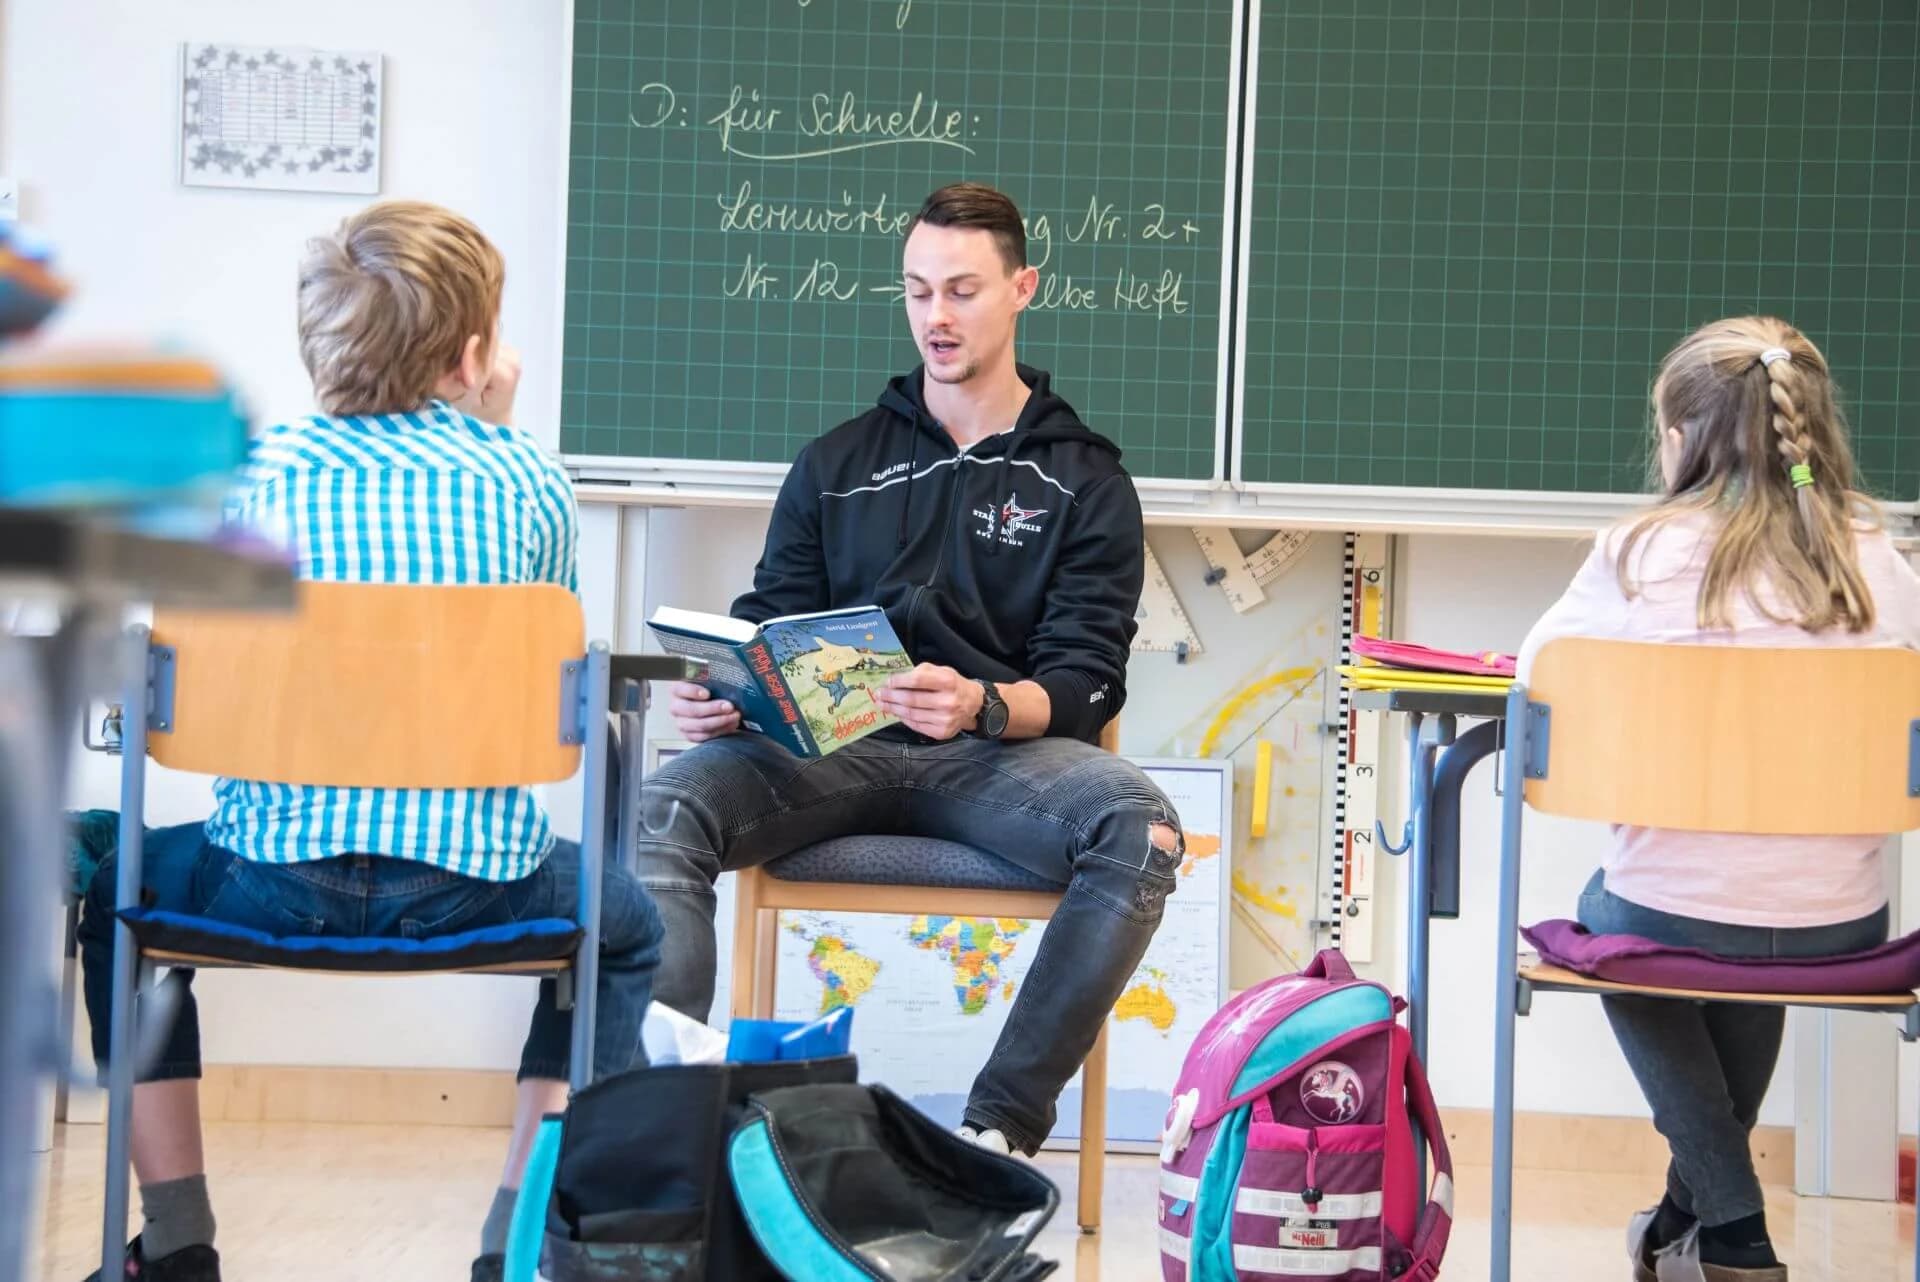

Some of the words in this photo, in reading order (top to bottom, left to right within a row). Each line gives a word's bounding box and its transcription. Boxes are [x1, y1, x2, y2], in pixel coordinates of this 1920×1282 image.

[708, 85, 782, 152] für
[800, 91, 980, 138] Schnelle:
[717, 180, 910, 236] Lernwörte
[1066, 195, 1127, 242] Nr.
[1142, 203, 1176, 240] 2
[723, 253, 779, 300] Nr.
[793, 258, 859, 301] 12
[1113, 267, 1189, 320] Heft
[835, 711, 877, 740] dieser
[1356, 766, 1374, 777] 3
[1354, 831, 1371, 844] 2
